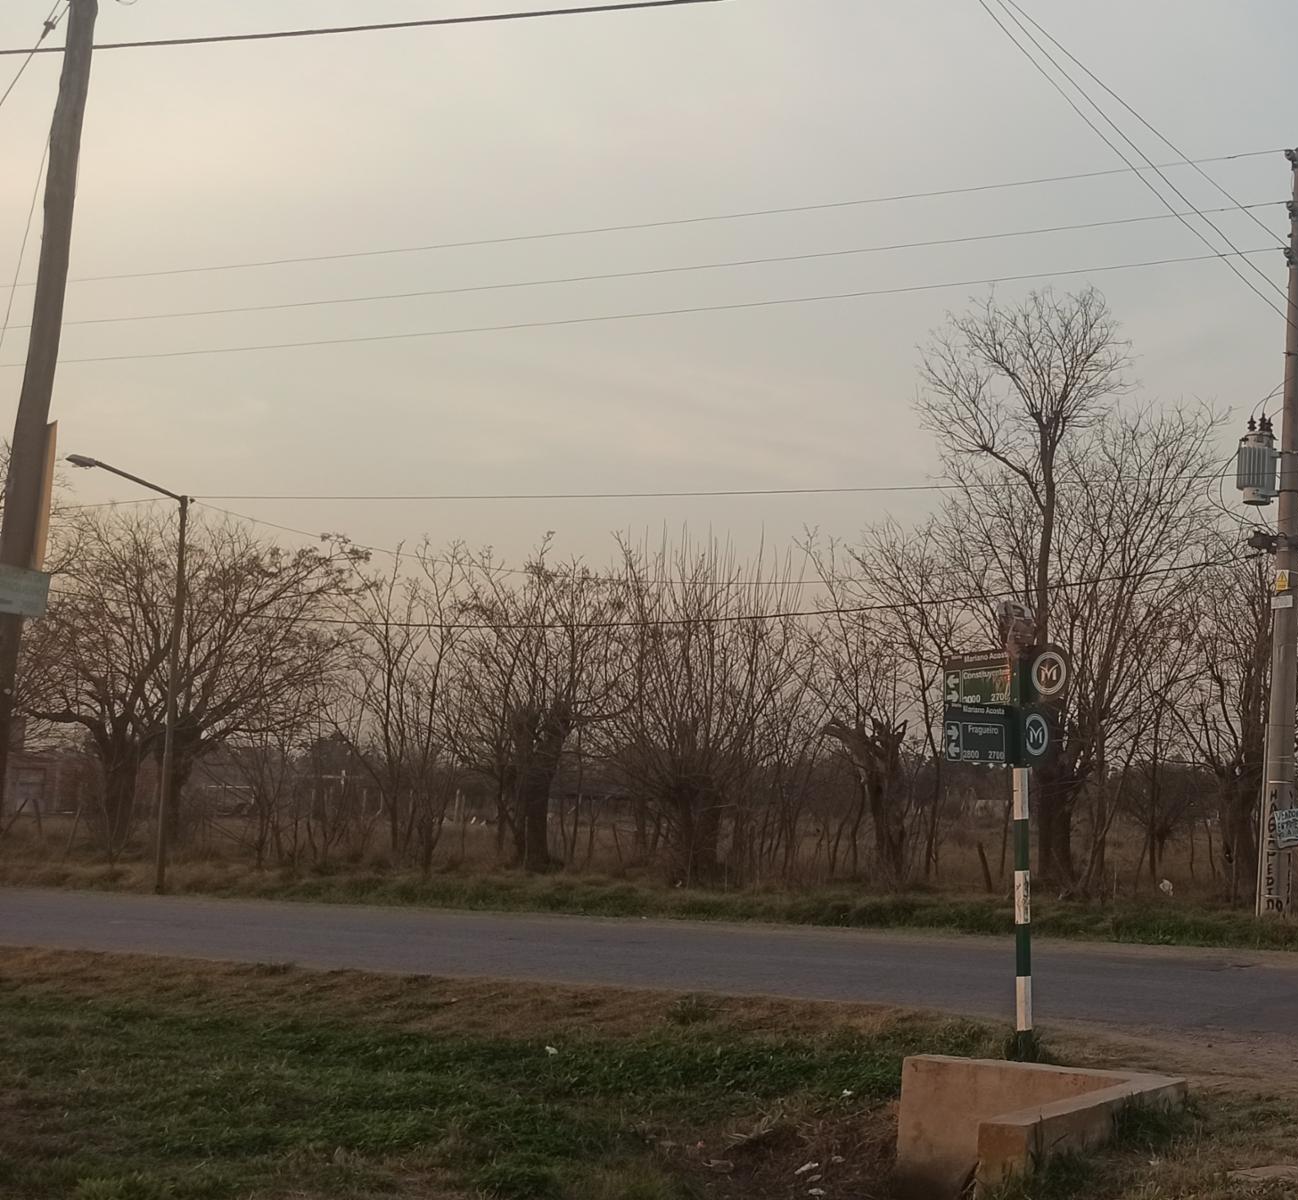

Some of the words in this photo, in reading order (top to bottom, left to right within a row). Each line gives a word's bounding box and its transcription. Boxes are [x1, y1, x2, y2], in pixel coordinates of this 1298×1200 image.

[964, 654, 988, 663] Mariano
[989, 652, 1008, 660] Acost
[963, 706, 986, 715] Mariano
[986, 707, 1005, 716] Acosta
[968, 725, 999, 736] Fragueiro
